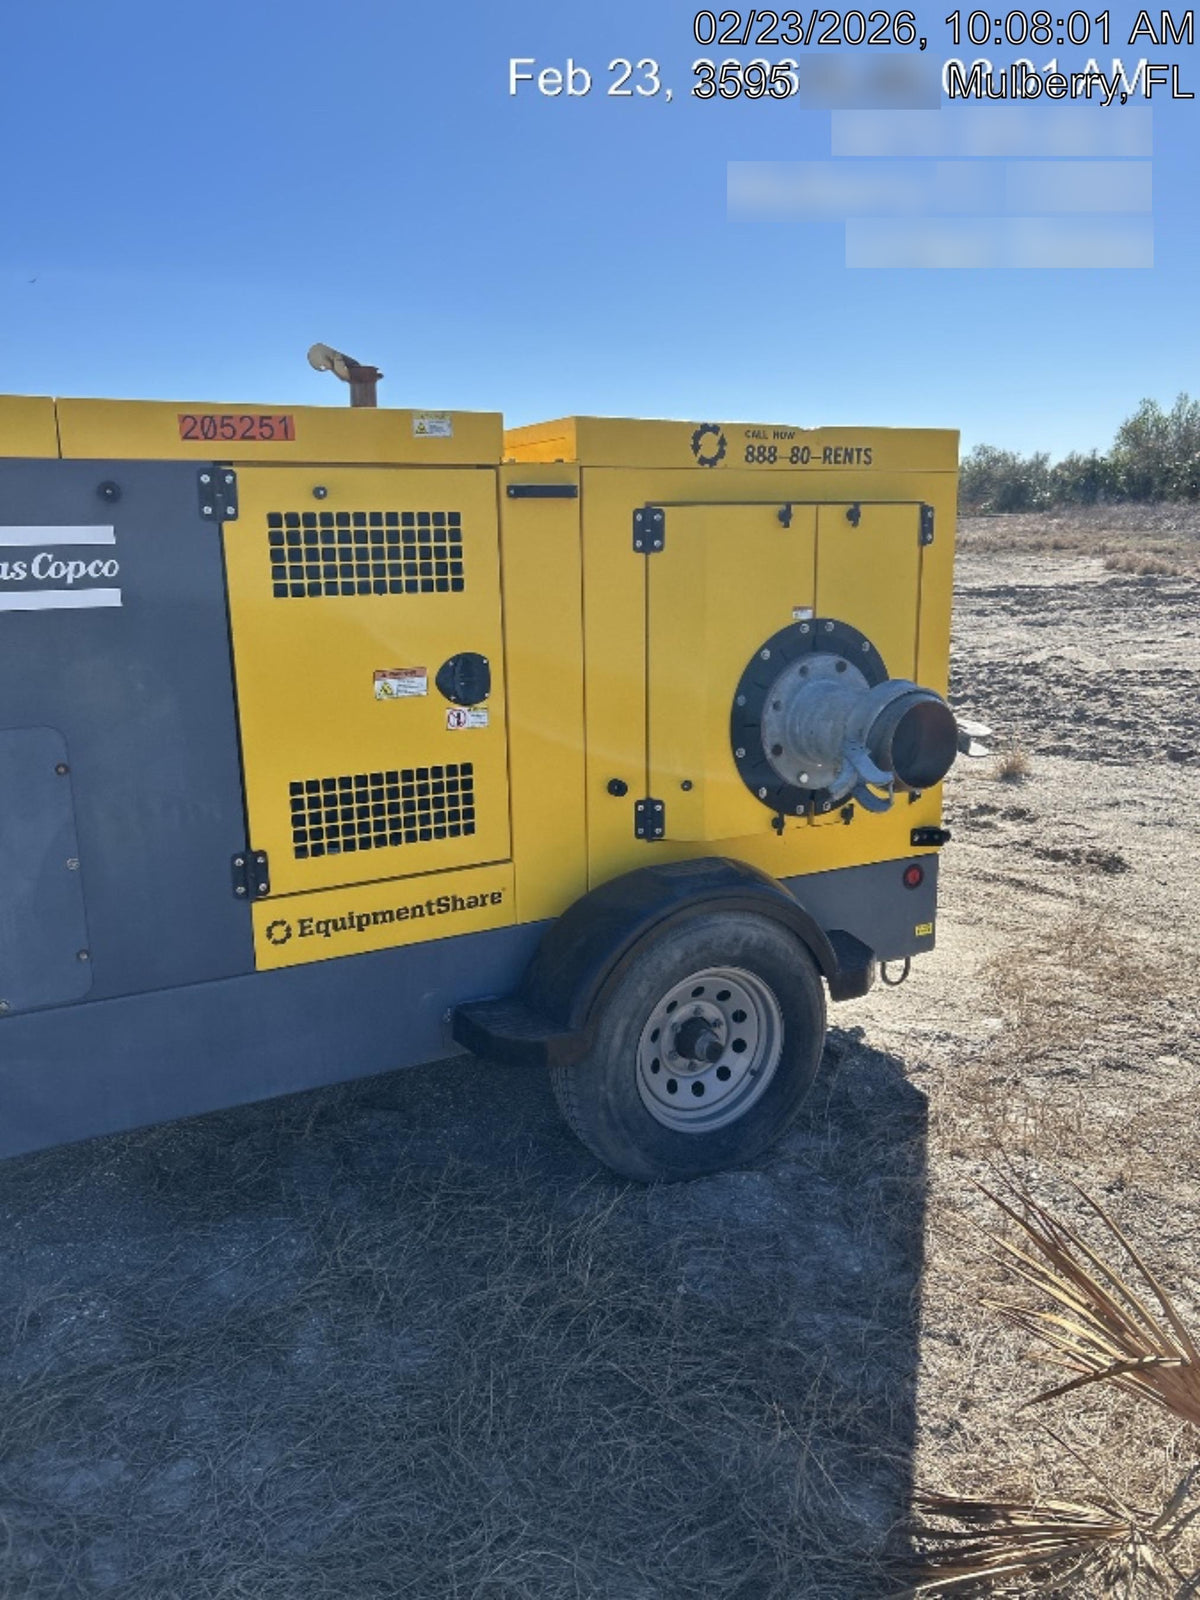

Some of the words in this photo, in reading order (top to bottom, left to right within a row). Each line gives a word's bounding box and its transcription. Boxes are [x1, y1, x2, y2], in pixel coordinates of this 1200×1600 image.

[181, 415, 290, 440] 205251
[744, 429, 769, 440] CALL
[31, 552, 120, 584] Copco
[297, 889, 504, 937] EquipmentShare
